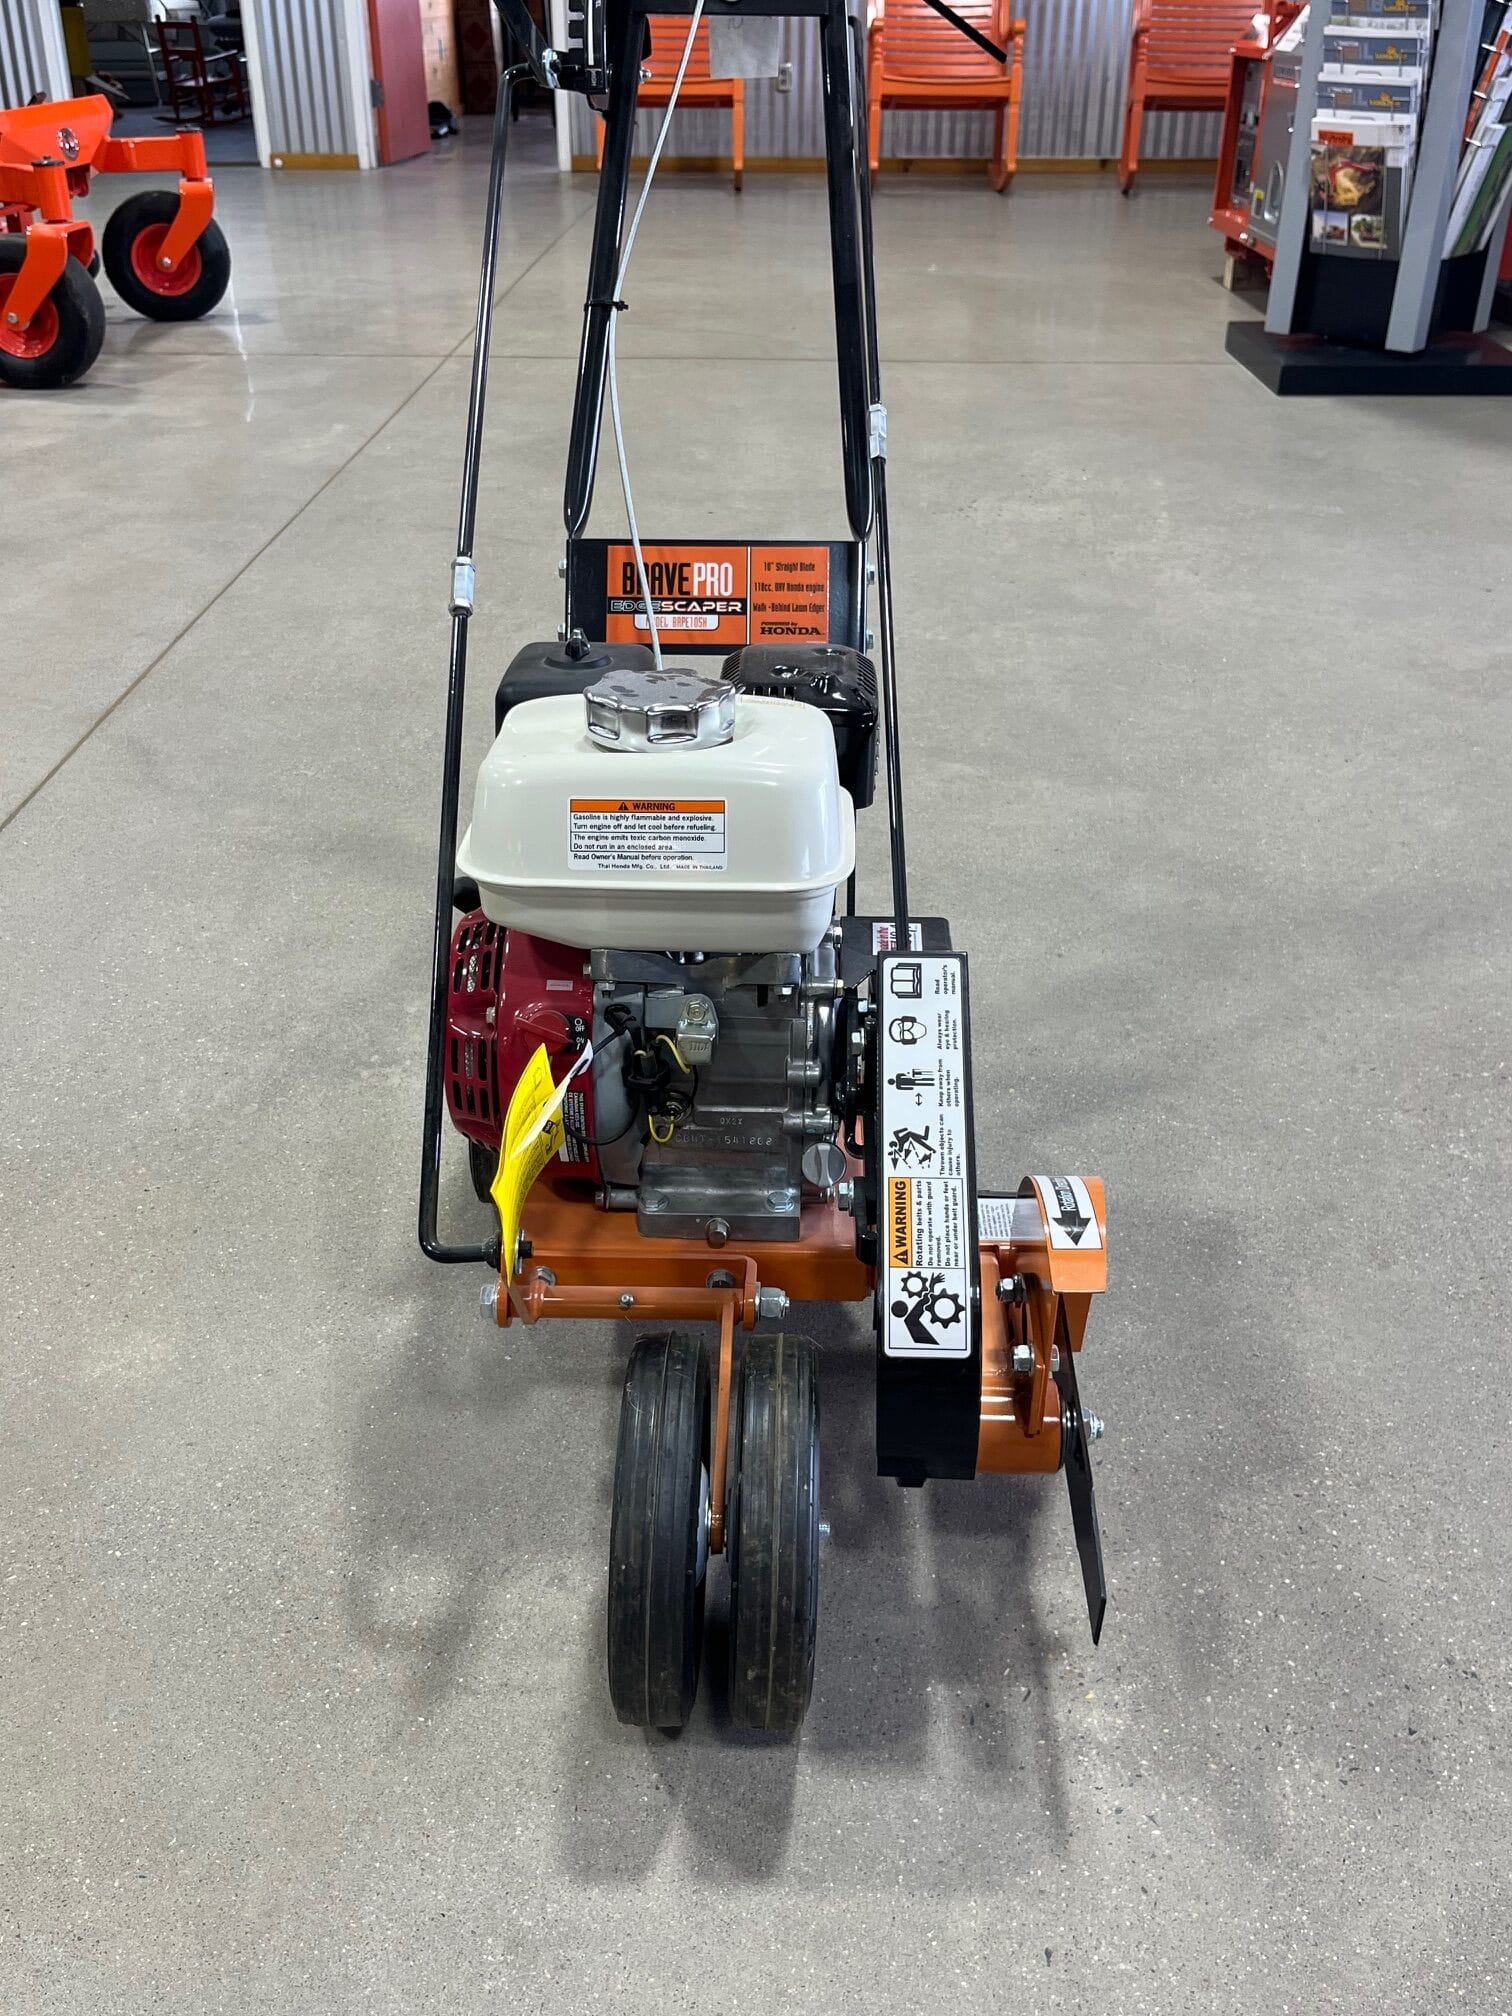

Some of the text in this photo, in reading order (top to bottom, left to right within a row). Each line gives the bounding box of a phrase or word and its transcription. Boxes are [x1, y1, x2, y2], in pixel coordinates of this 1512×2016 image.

[776, 562, 798, 573] Straight
[800, 562, 815, 571] Blade
[787, 583, 804, 592] Honda
[806, 583, 824, 593] engine
[792, 603, 807, 612] Lawn
[809, 603, 824, 614] Edger
[895, 1181, 906, 1248] WARNING
[916, 1228, 924, 1266] Rotating
[928, 1257, 933, 1266] Do
[945, 1258, 950, 1266] Do
